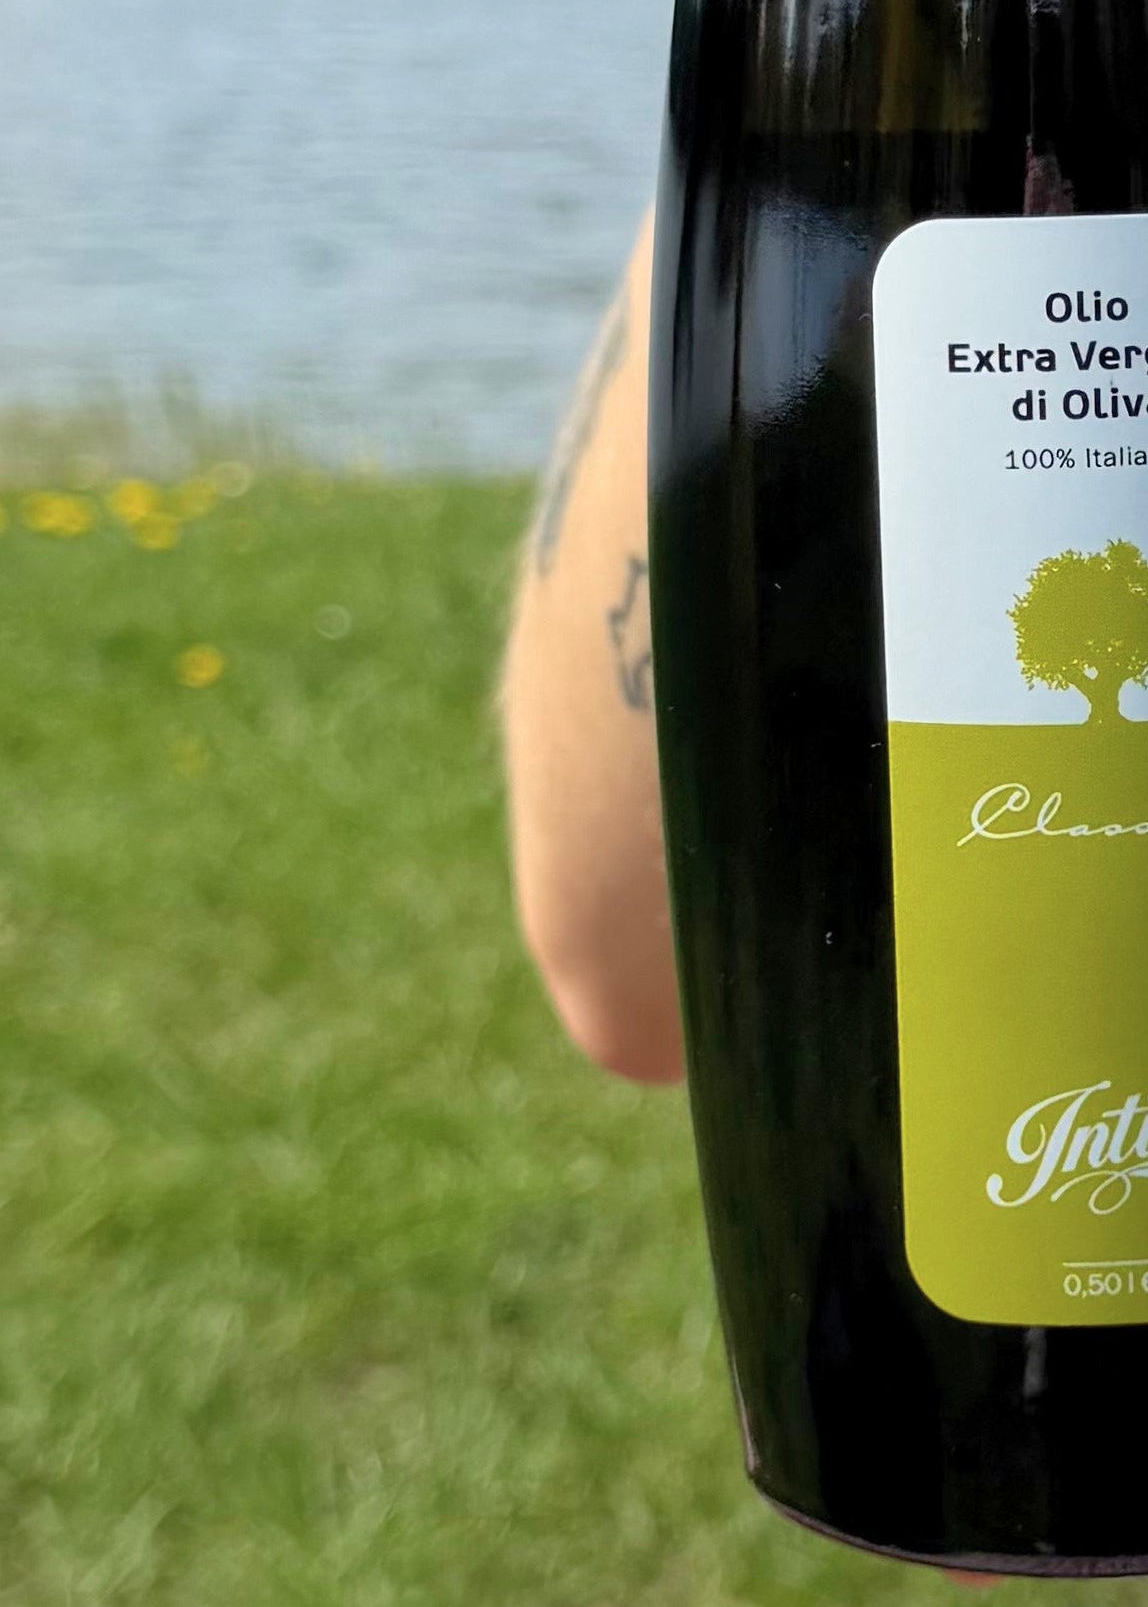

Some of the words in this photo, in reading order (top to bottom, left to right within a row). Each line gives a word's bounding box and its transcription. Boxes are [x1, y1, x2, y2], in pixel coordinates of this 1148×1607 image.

[1045, 290, 1129, 323] Olio
[947, 343, 1057, 373] Extra
[1011, 389, 1046, 421] di
[1004, 448, 1076, 471] 100%
